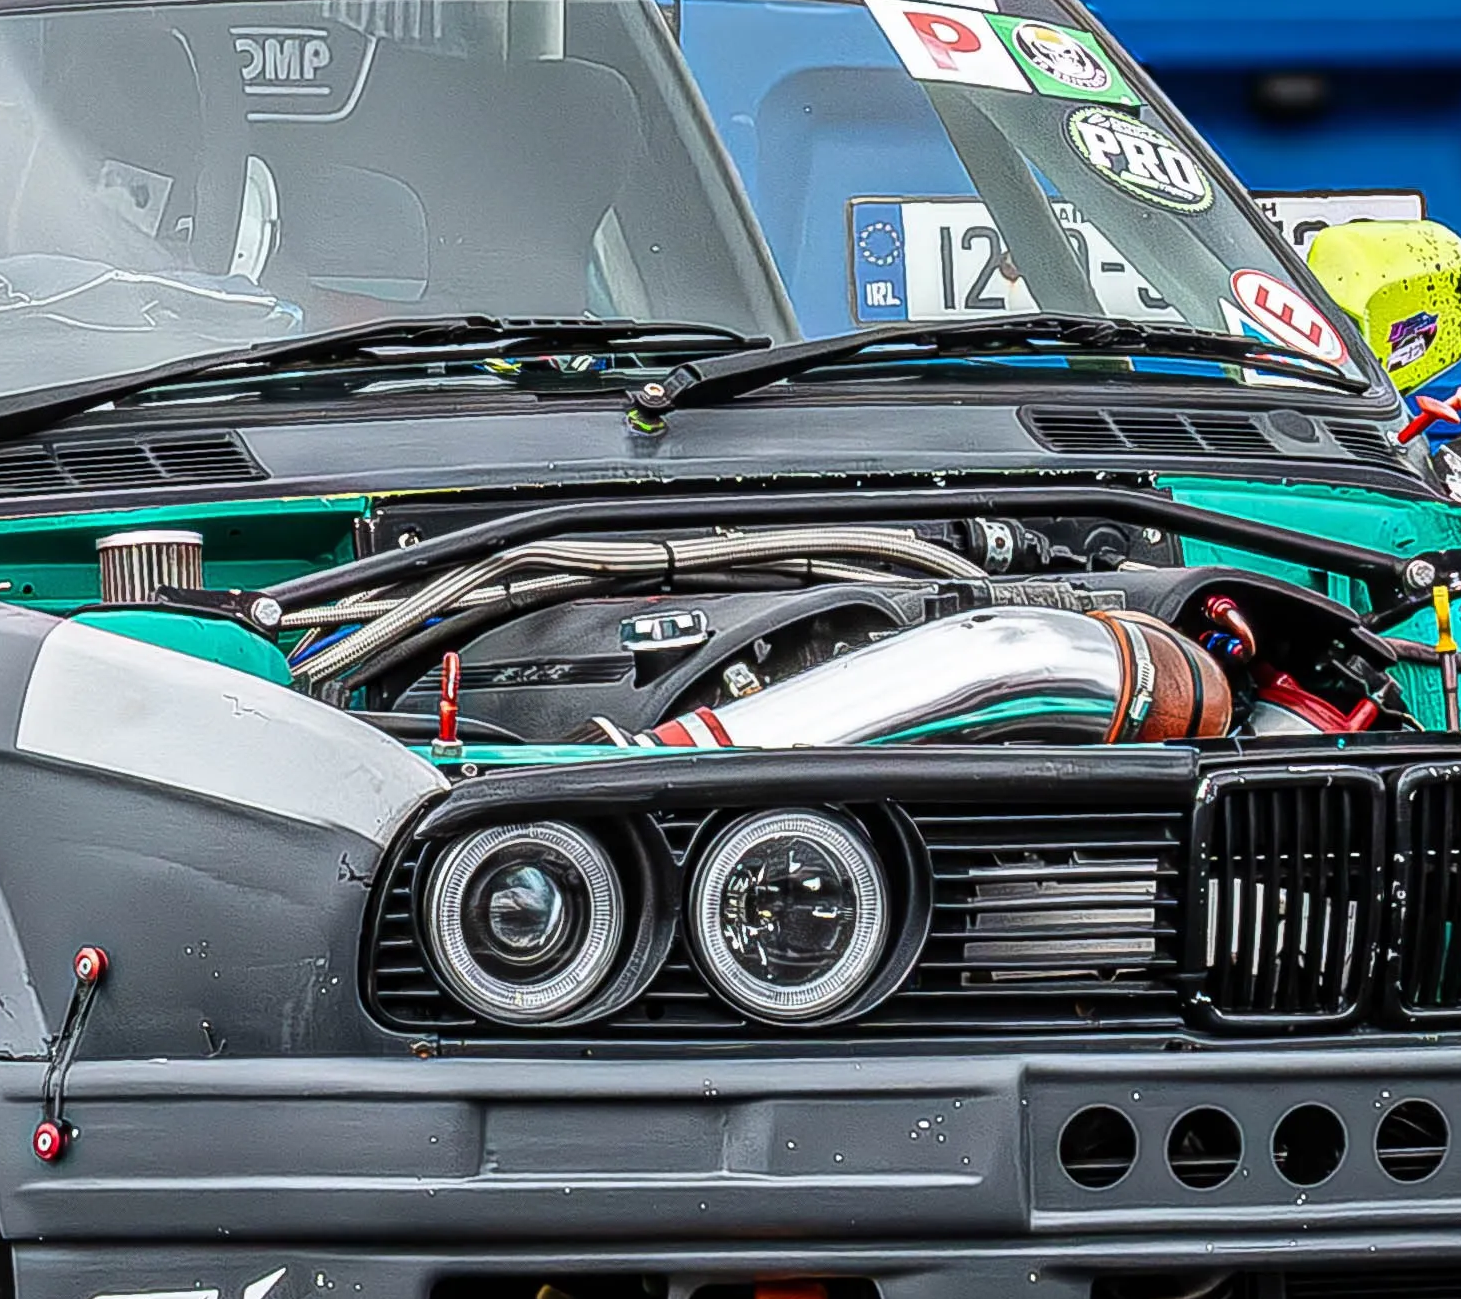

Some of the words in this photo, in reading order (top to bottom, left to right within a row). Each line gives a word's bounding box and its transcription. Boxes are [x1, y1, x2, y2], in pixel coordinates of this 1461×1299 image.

[903, 12, 982, 71] P
[1075, 121, 1206, 197] PRO
[866, 280, 901, 308] IRL
